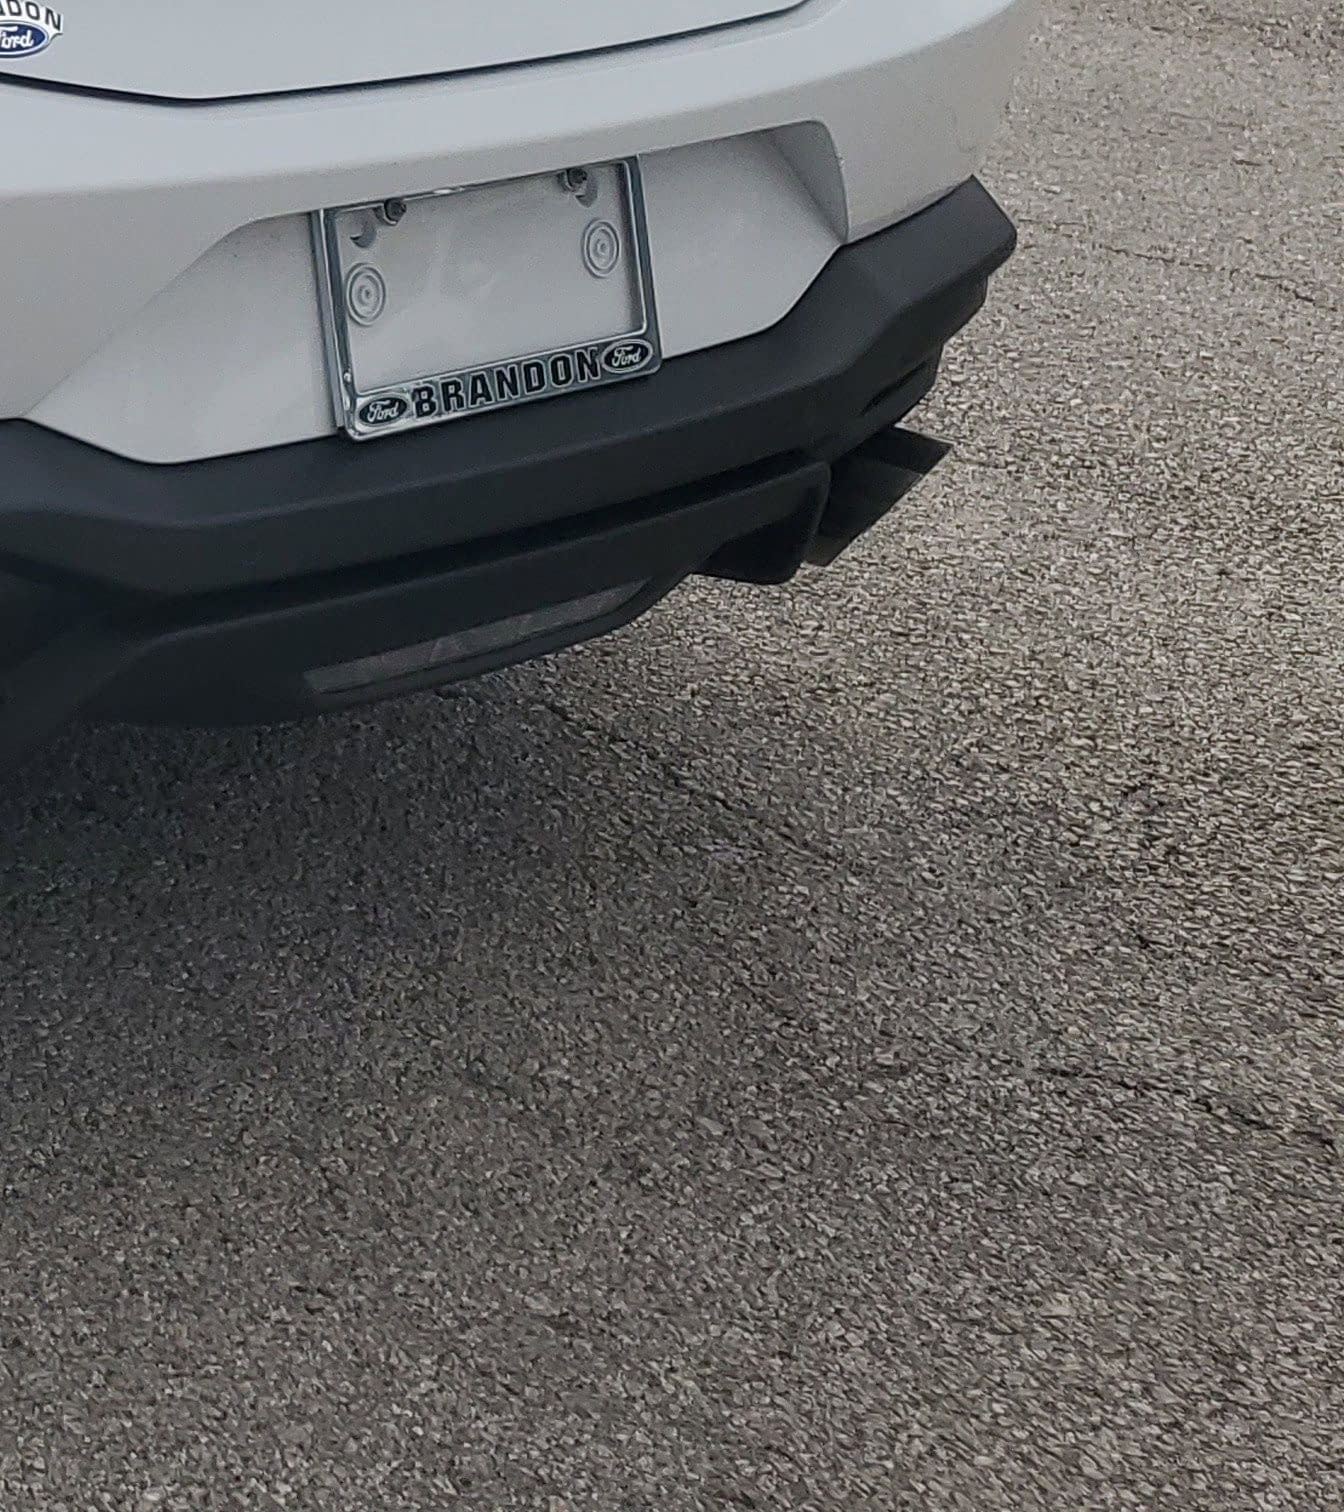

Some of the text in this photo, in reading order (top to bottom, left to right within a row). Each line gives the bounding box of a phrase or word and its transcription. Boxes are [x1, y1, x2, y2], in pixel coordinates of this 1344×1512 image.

[366, 346, 644, 423] Ford BRANDON Ford
